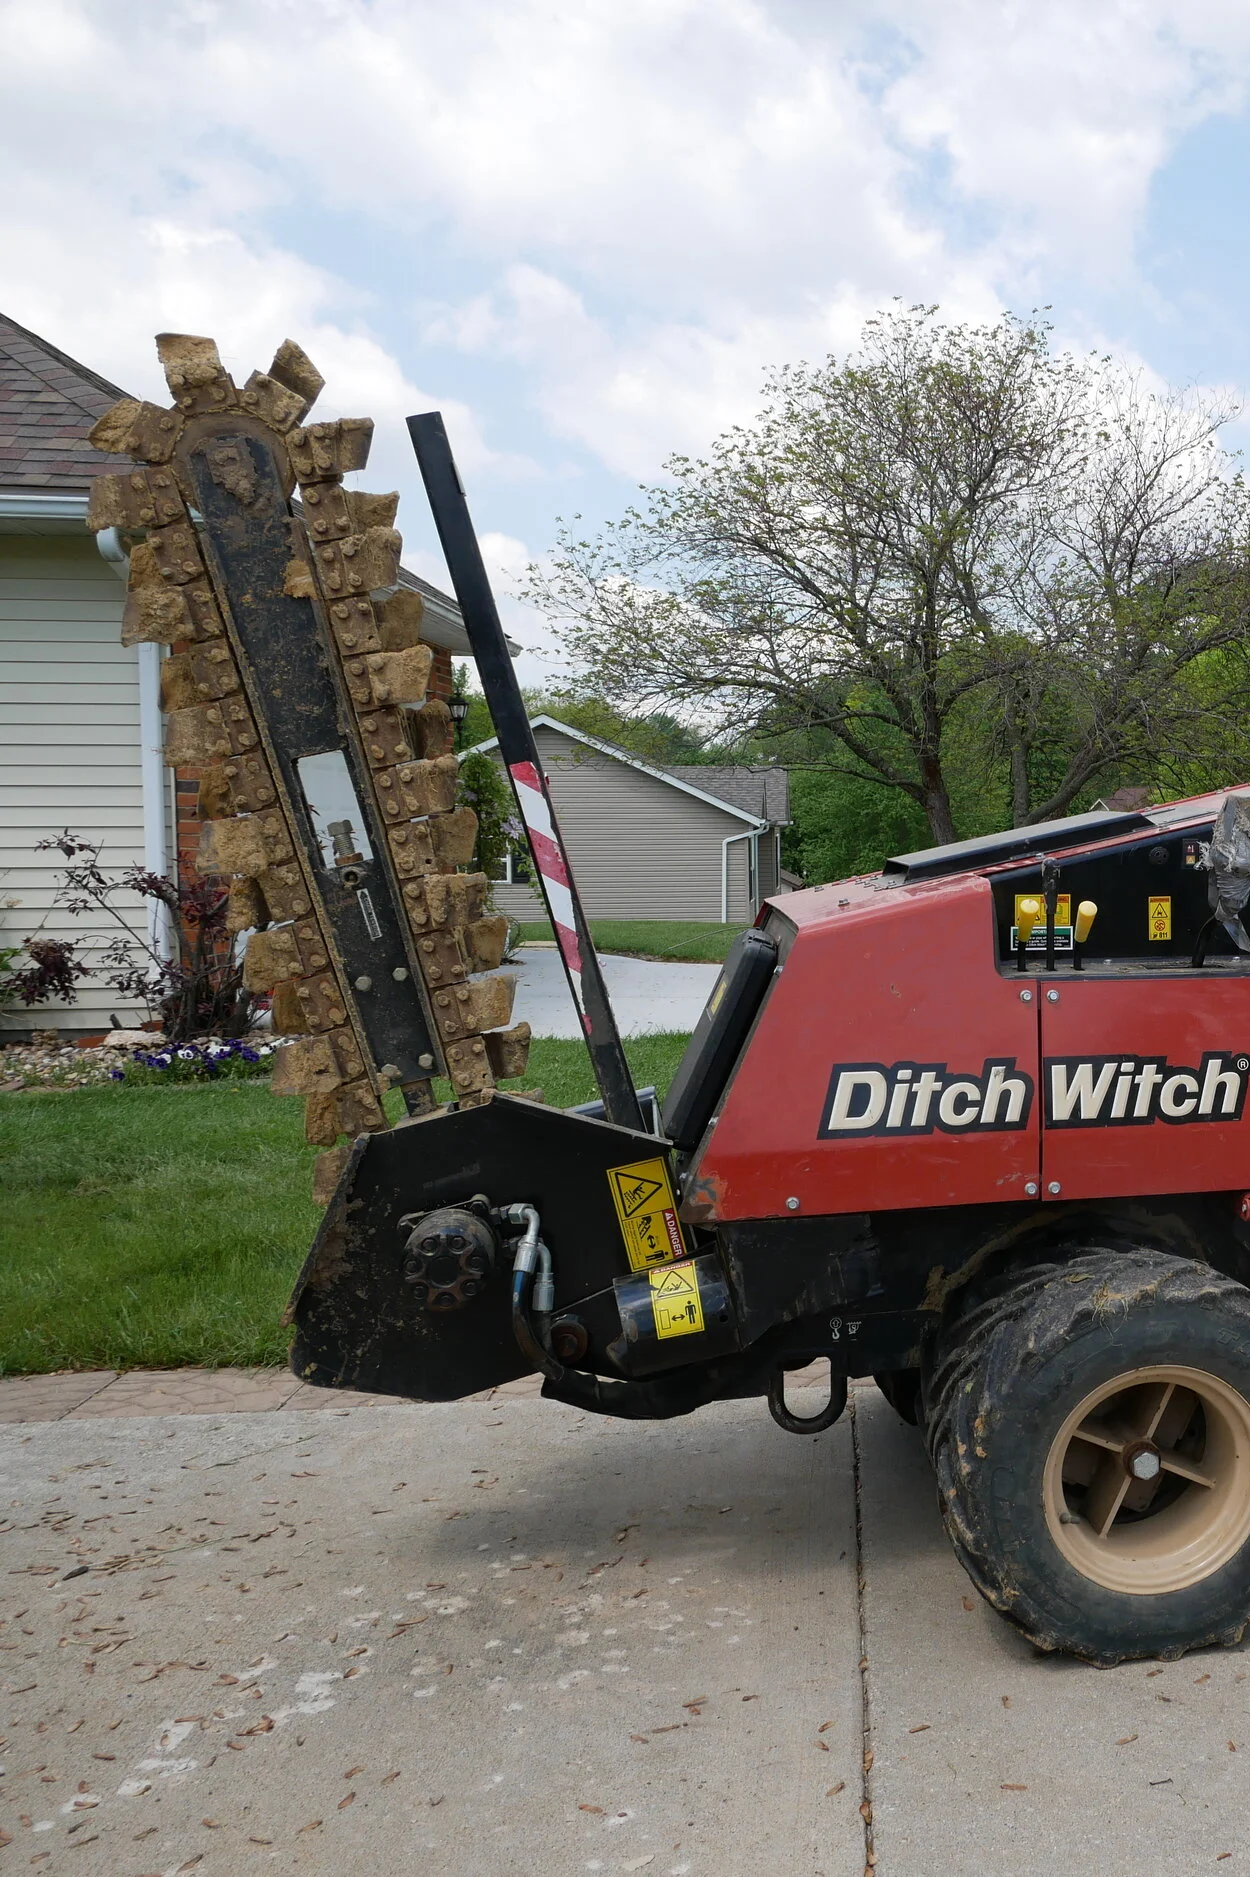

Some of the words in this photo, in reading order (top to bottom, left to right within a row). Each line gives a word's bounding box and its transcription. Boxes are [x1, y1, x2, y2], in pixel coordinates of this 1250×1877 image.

[827, 1065, 1027, 1131] Ditch
[667, 1220, 683, 1256] DANGER
[661, 1261, 691, 1271] DANGER
